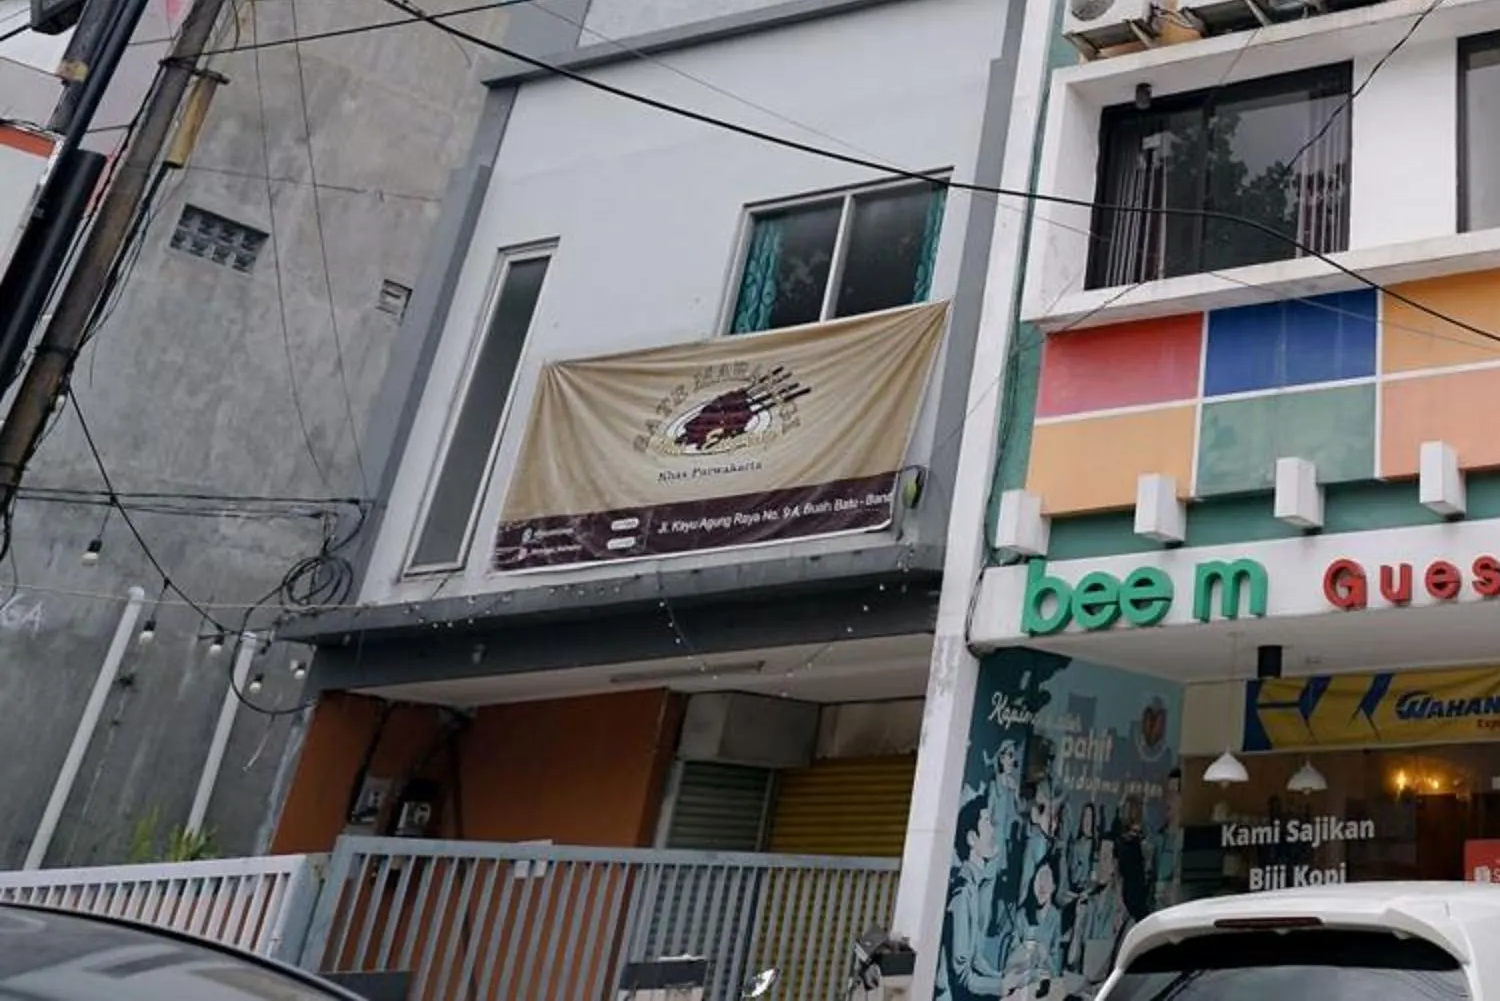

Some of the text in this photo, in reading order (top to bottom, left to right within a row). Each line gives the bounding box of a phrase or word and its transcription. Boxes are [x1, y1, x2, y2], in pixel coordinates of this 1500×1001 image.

[1021, 557, 1175, 637] bee
[1221, 815, 1375, 847] Kami Sajikan
